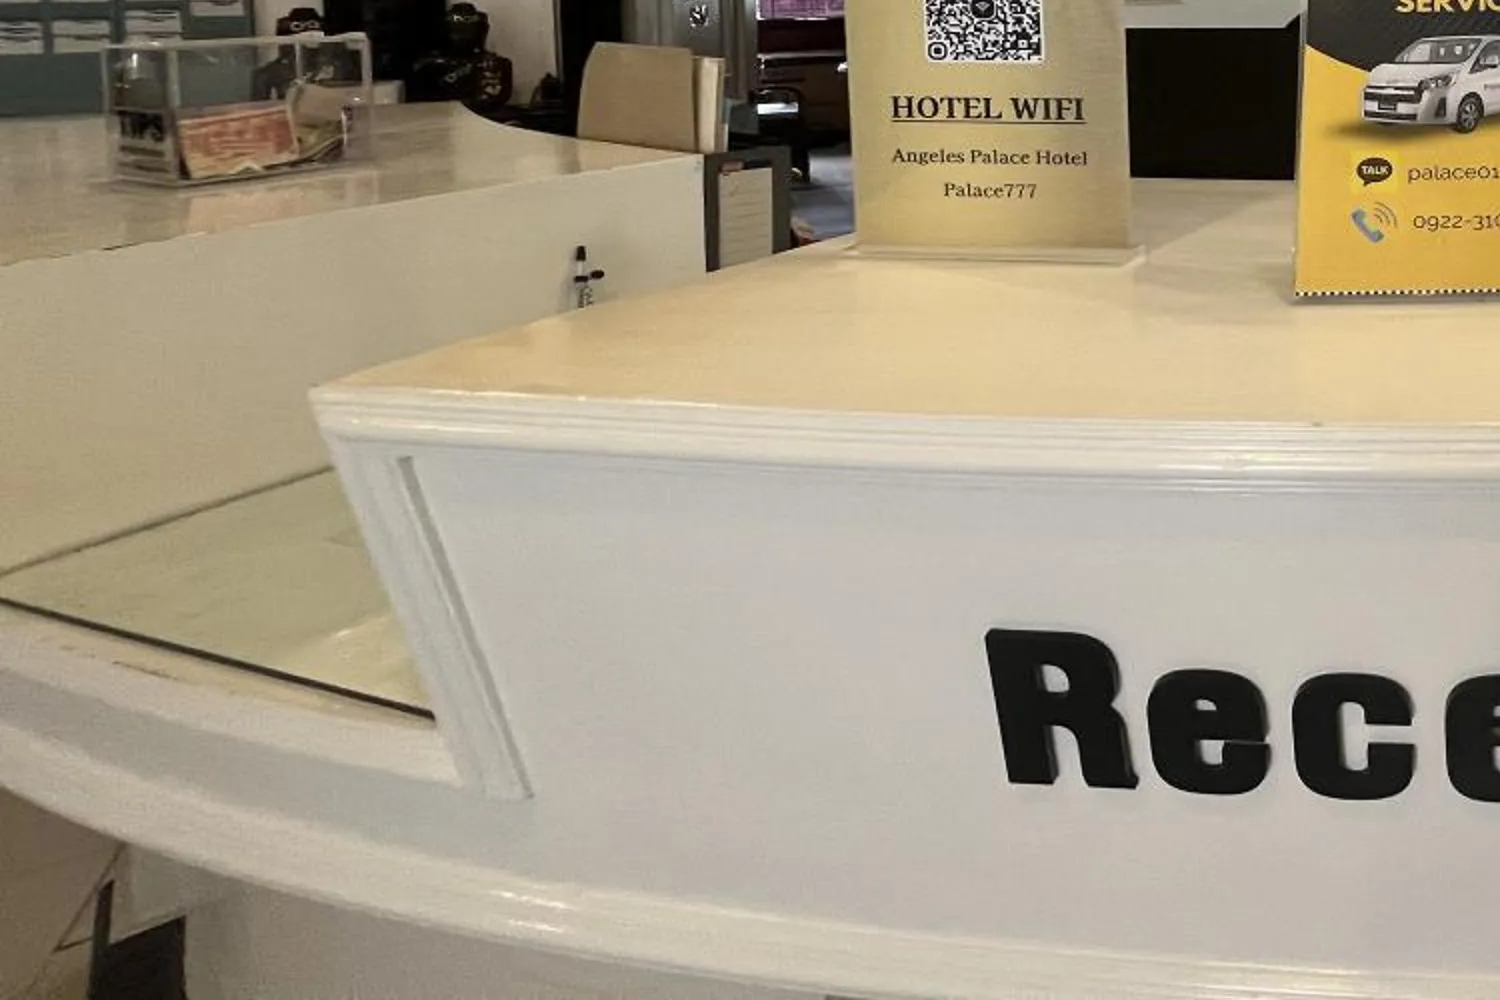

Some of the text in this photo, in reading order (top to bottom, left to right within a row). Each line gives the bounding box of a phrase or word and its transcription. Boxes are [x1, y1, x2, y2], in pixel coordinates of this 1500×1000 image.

[891, 96, 1086, 121] HOTEL WIFI
[891, 148, 1088, 167] Angeles Palace Hotel
[1361, 164, 1500, 184] TALK palace01
[943, 183, 1038, 199] Palace777
